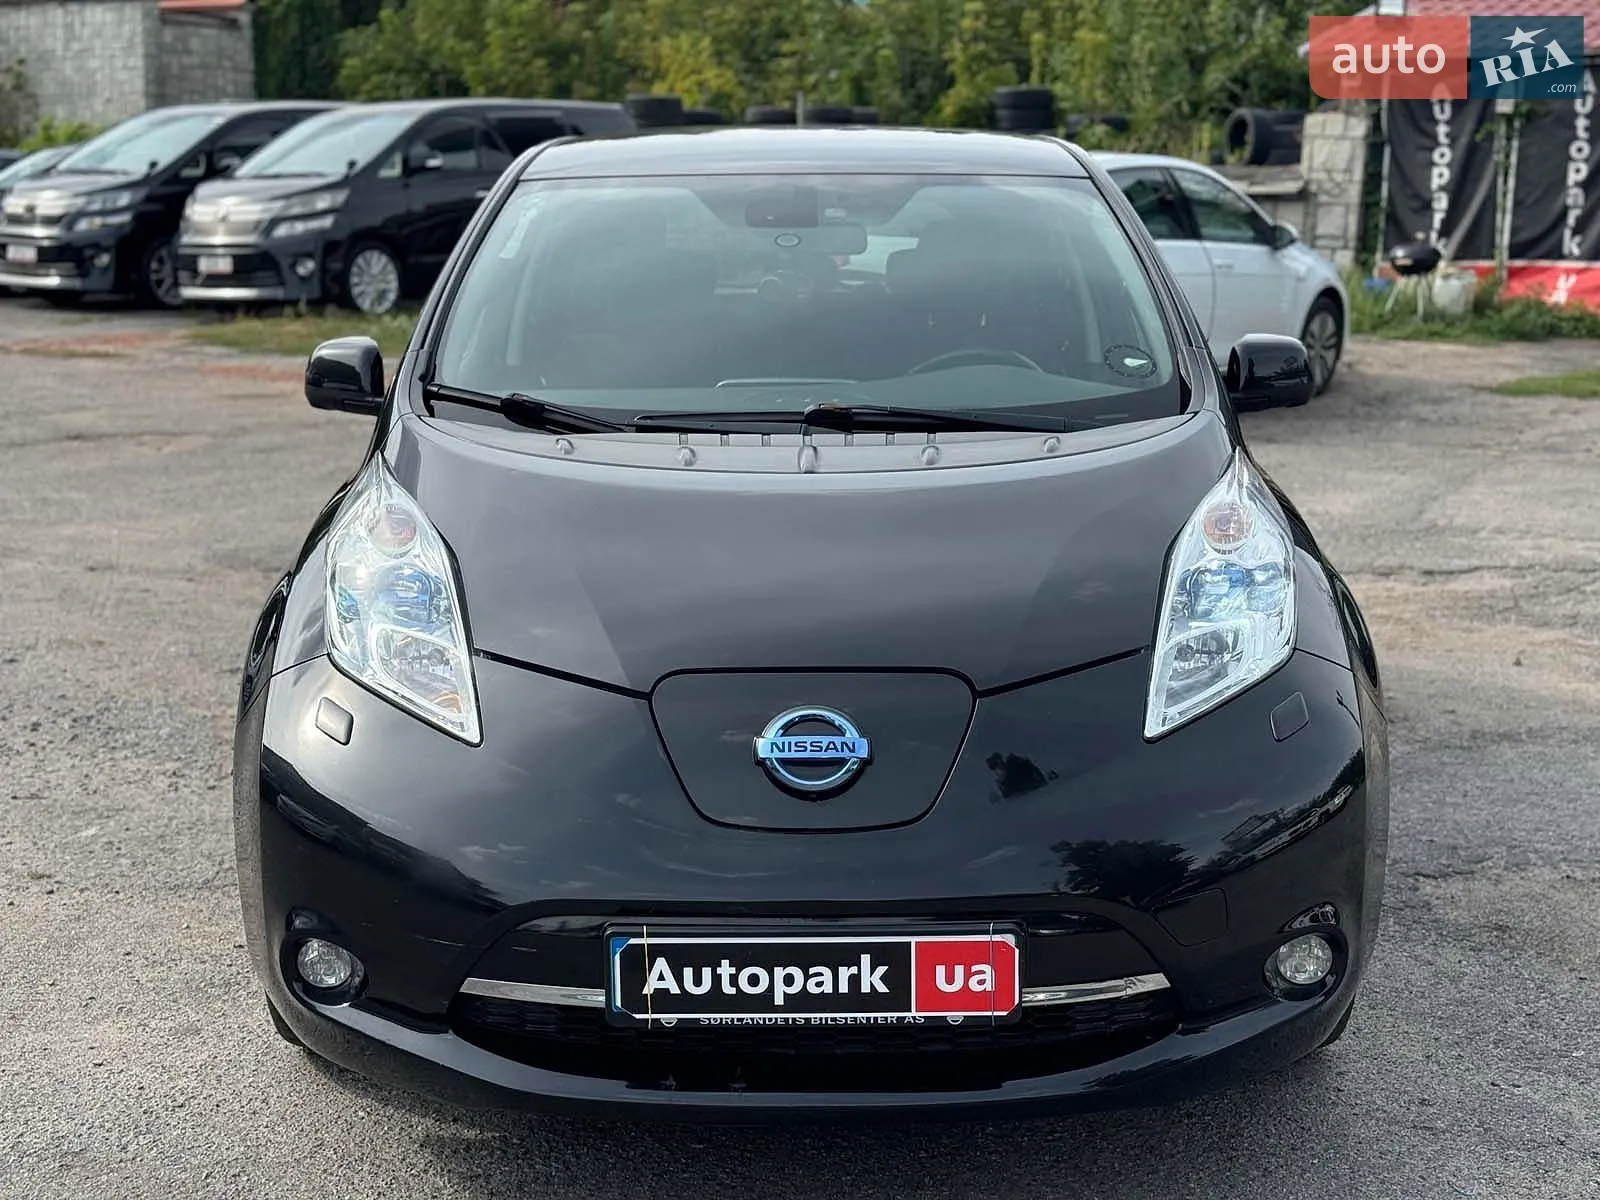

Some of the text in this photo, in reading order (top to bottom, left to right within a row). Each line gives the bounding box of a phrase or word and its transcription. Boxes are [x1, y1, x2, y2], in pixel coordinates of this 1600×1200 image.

[770, 741, 856, 753] NISSAN
[642, 954, 996, 1005] Autopark ua
[903, 1015, 926, 1024] AS
